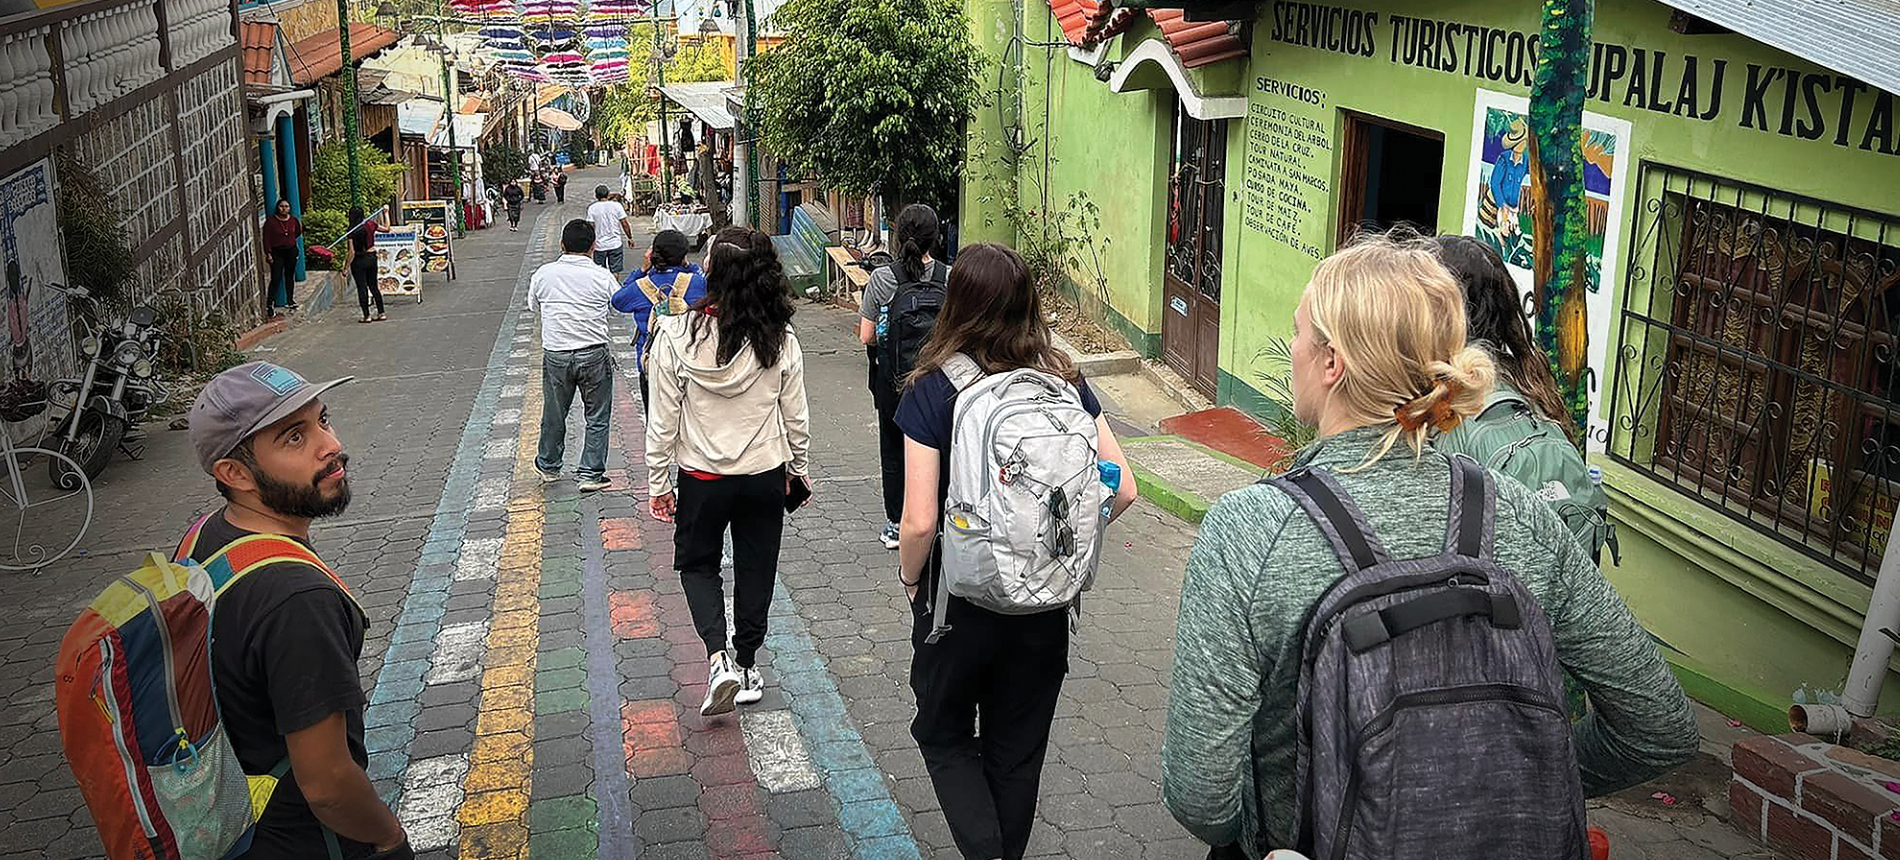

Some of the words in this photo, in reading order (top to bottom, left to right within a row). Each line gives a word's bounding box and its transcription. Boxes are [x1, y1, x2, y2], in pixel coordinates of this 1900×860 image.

[1271, 1, 1378, 58] SERVICIOS
[1389, 14, 1540, 86] TURISTICOS
[1739, 63, 1900, 156] K'ISTA
[1256, 77, 1326, 109] SERVICIOS:
[1251, 103, 1286, 121] CIRCUITO
[1289, 114, 1325, 134] CULTURAL
[1249, 129, 1270, 143] CERRO
[1250, 116, 1292, 137] CEREMONIA
[1294, 129, 1305, 142] DEL
[1249, 142, 1266, 155] TOUR
[1248, 154, 1281, 174] CAMINATA
[1282, 167, 1288, 176] A
[1288, 168, 1301, 181] SAN
[1248, 166, 1276, 185] POSADA
[1246, 179, 1264, 193] CURSO
[1267, 187, 1275, 198] DE
[1247, 191, 1263, 205] TOUR
[1266, 200, 1274, 211] DE
[1246, 203, 1263, 217] TOUR
[1266, 212, 1274, 224] DE
[1290, 237, 1299, 250] DE
